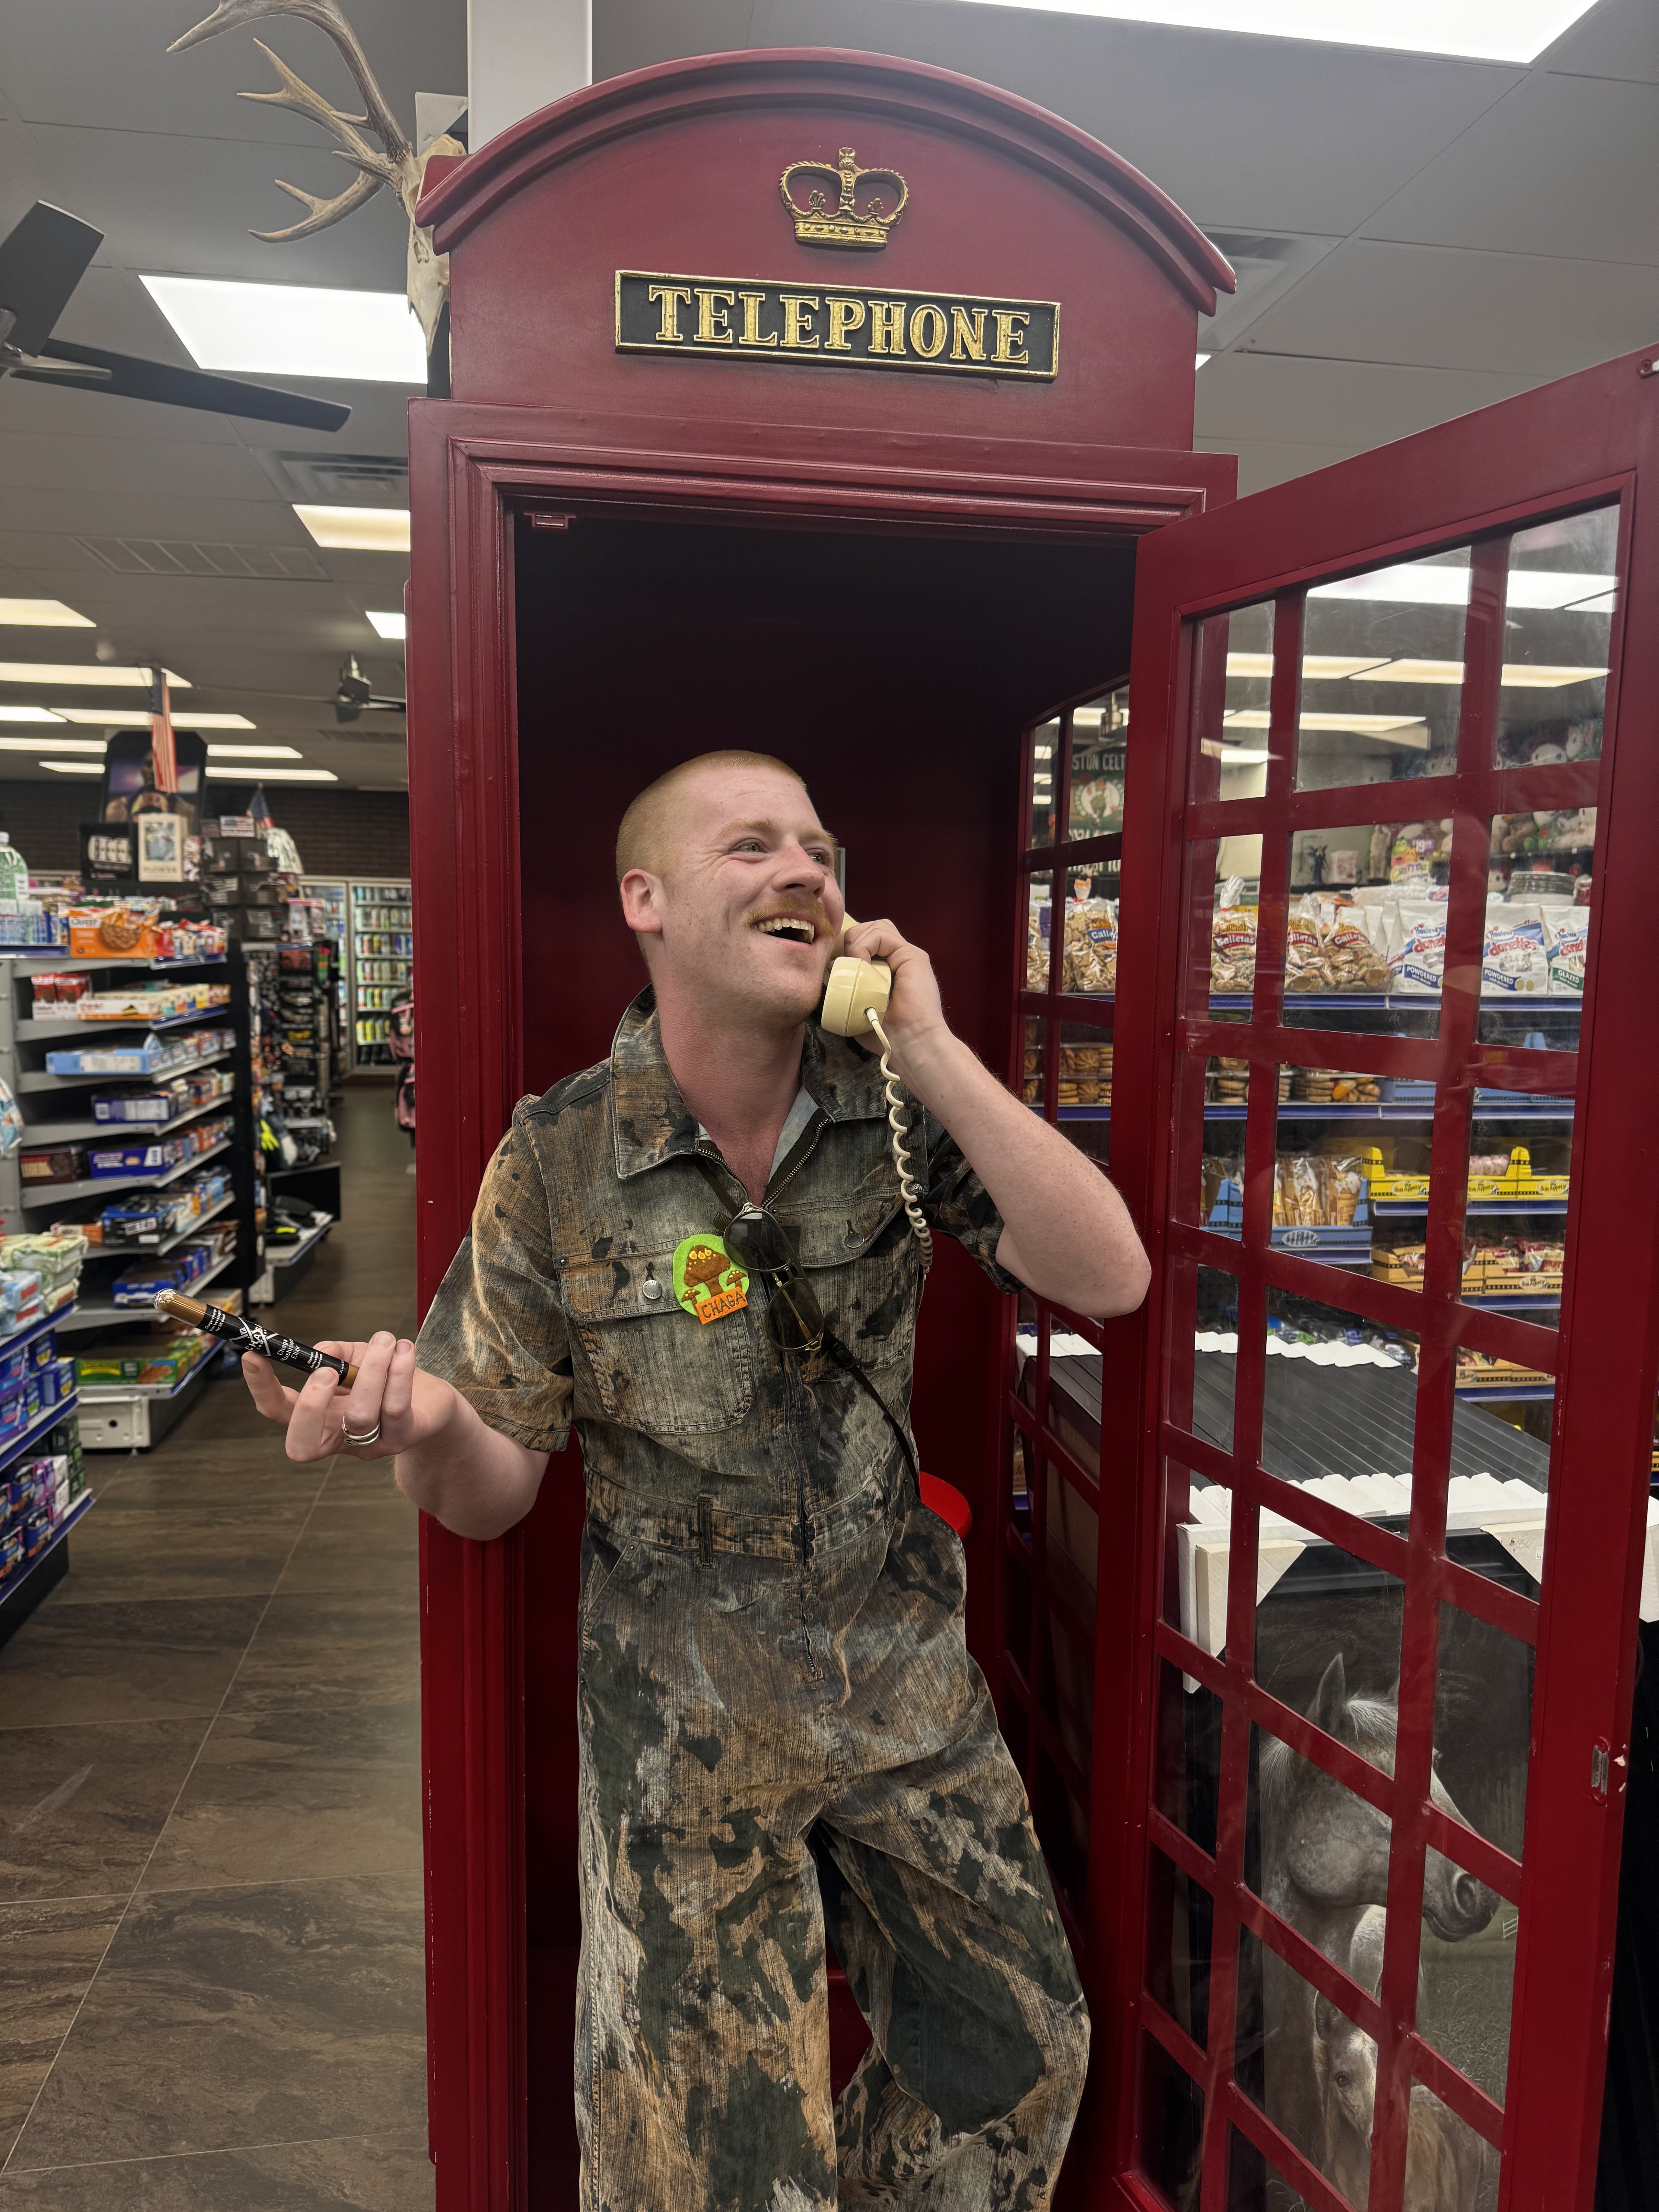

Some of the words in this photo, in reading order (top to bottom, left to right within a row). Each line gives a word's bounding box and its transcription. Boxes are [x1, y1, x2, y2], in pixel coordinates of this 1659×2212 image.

[648, 284, 1030, 365] TELEPHONE
[1072, 753, 1099, 770] STON
[1103, 753, 1125, 770] CELT
[1288, 932, 1317, 945] alletas
[1489, 930, 1513, 938] Hostess
[1413, 934, 1446, 953] donet
[1489, 937, 1538, 957] donettes
[1560, 939, 1586, 957] donet
[1406, 966, 1437, 982] POWDERED
[1484, 969, 1513, 985] POWDERED
[1557, 969, 1580, 984] GLAZED
[700, 1290, 746, 1318] CHAGA
[277, 1339, 289, 1356] Chaga
[291, 1345, 301, 1360] Elixir
